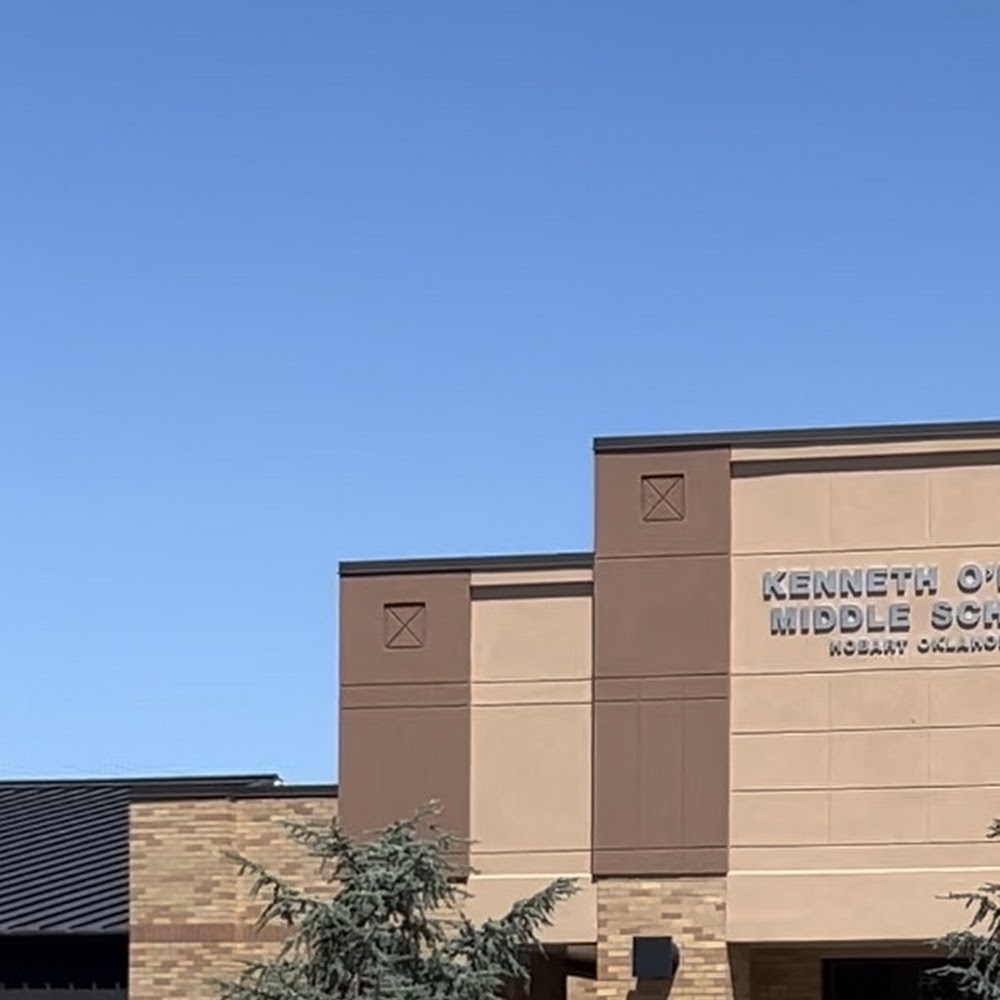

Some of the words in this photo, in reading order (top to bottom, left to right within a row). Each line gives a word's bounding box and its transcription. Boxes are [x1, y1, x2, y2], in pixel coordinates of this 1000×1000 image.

[762, 567, 938, 600] KENNETH
[770, 603, 911, 635] MIDDLE
[829, 639, 908, 657] HOBART
